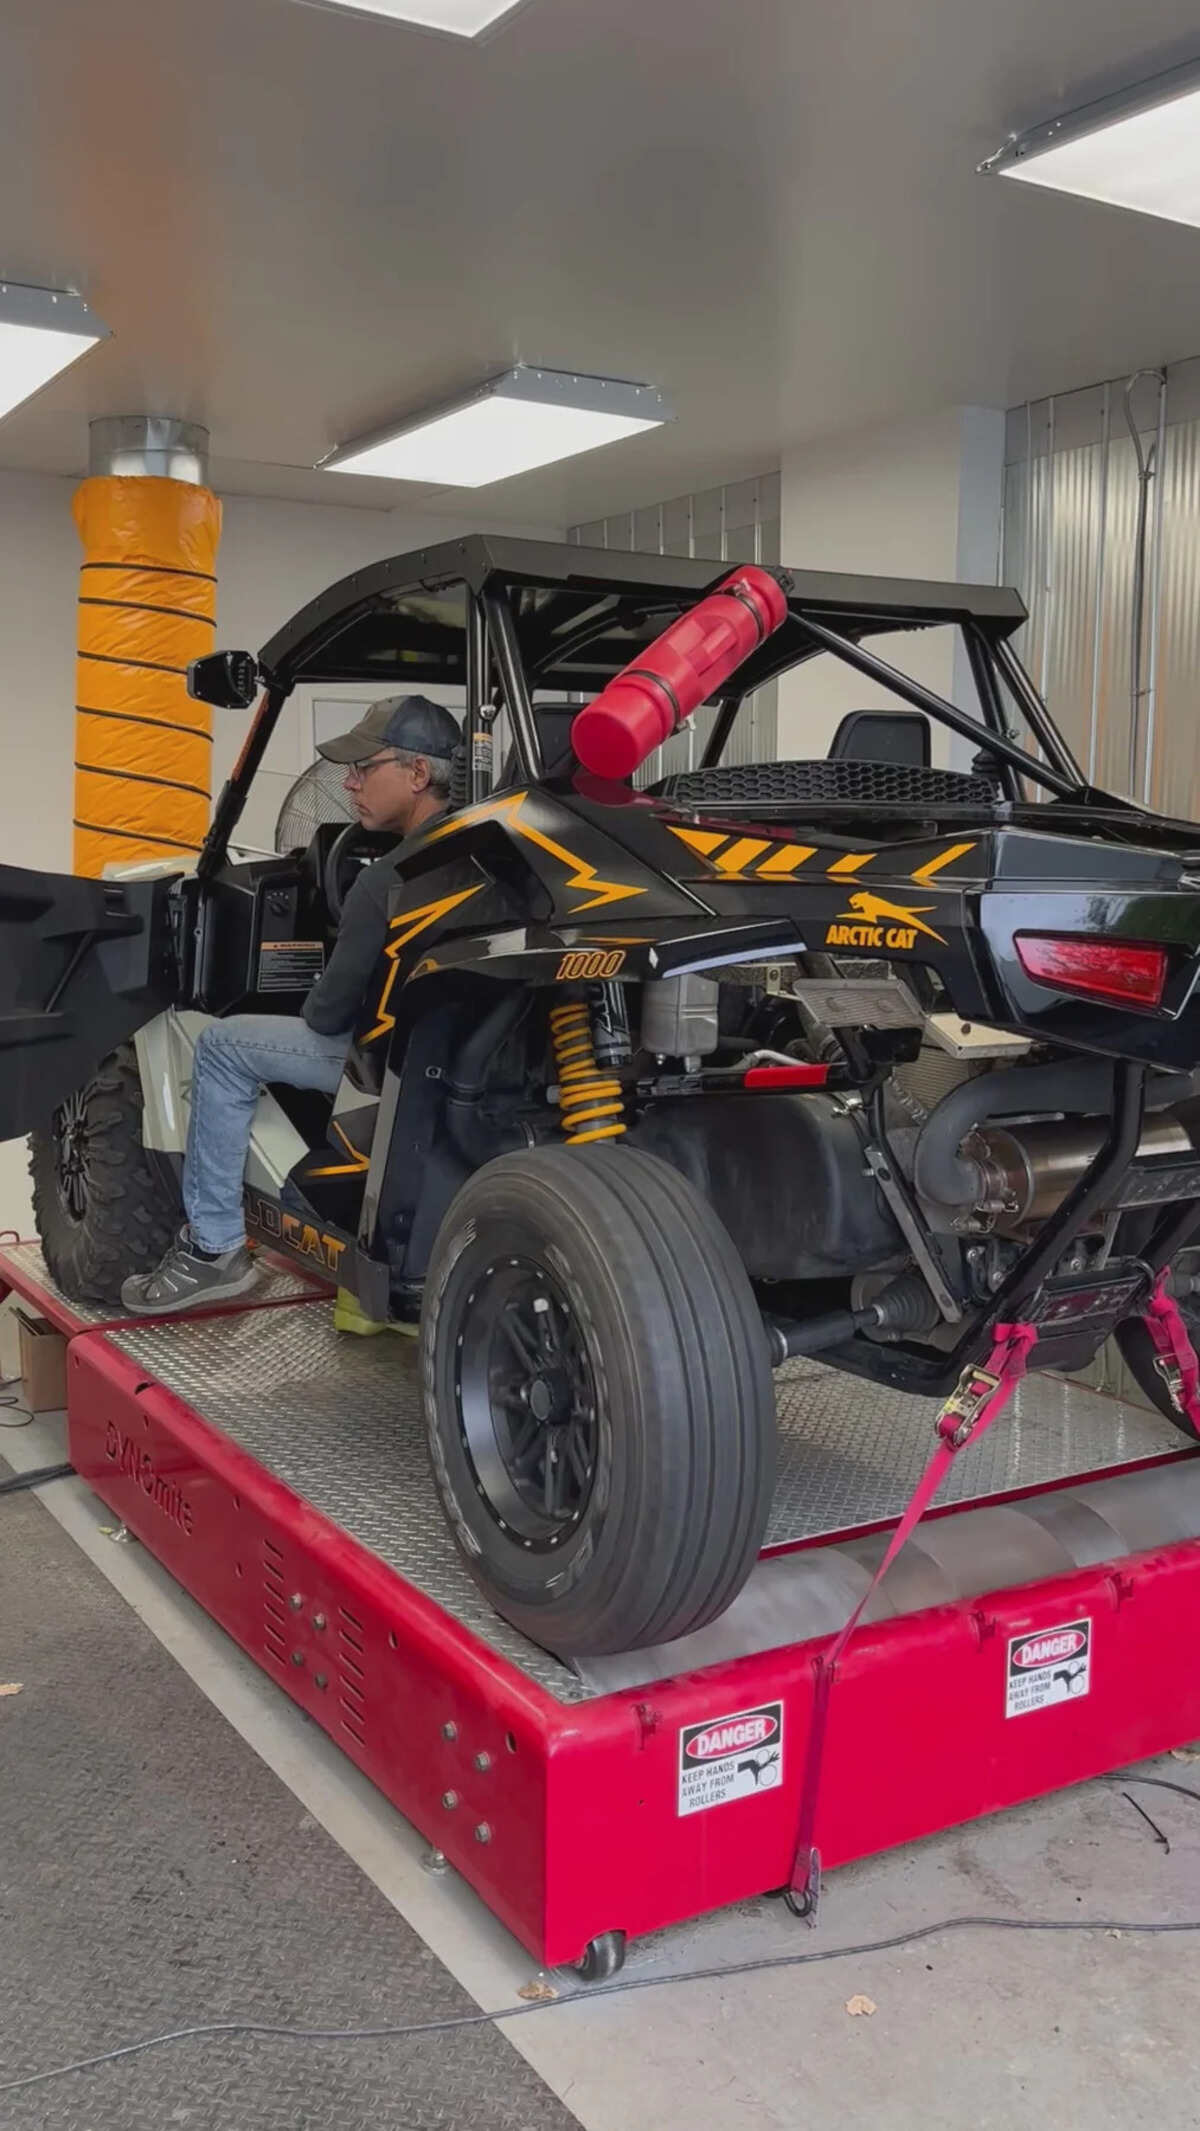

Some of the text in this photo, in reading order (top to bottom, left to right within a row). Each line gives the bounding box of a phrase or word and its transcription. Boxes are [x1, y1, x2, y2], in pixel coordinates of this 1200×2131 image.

[826, 925, 918, 949] ARCTIC CAT
[556, 950, 626, 980] 1000
[106, 1420, 192, 1536] DYNOmite
[1021, 1634, 1077, 1665] DANGER
[1010, 1670, 1051, 1689] KEEP HANDS
[1031, 1681, 1051, 1693] FROM
[1014, 1695, 1045, 1711] ROLLERS
[697, 1719, 766, 1755] DANGER
[682, 1761, 735, 1784] KEEP HANDS
[682, 1774, 735, 1798] AWAY FROM
[689, 1789, 726, 1808] ROLLERS
